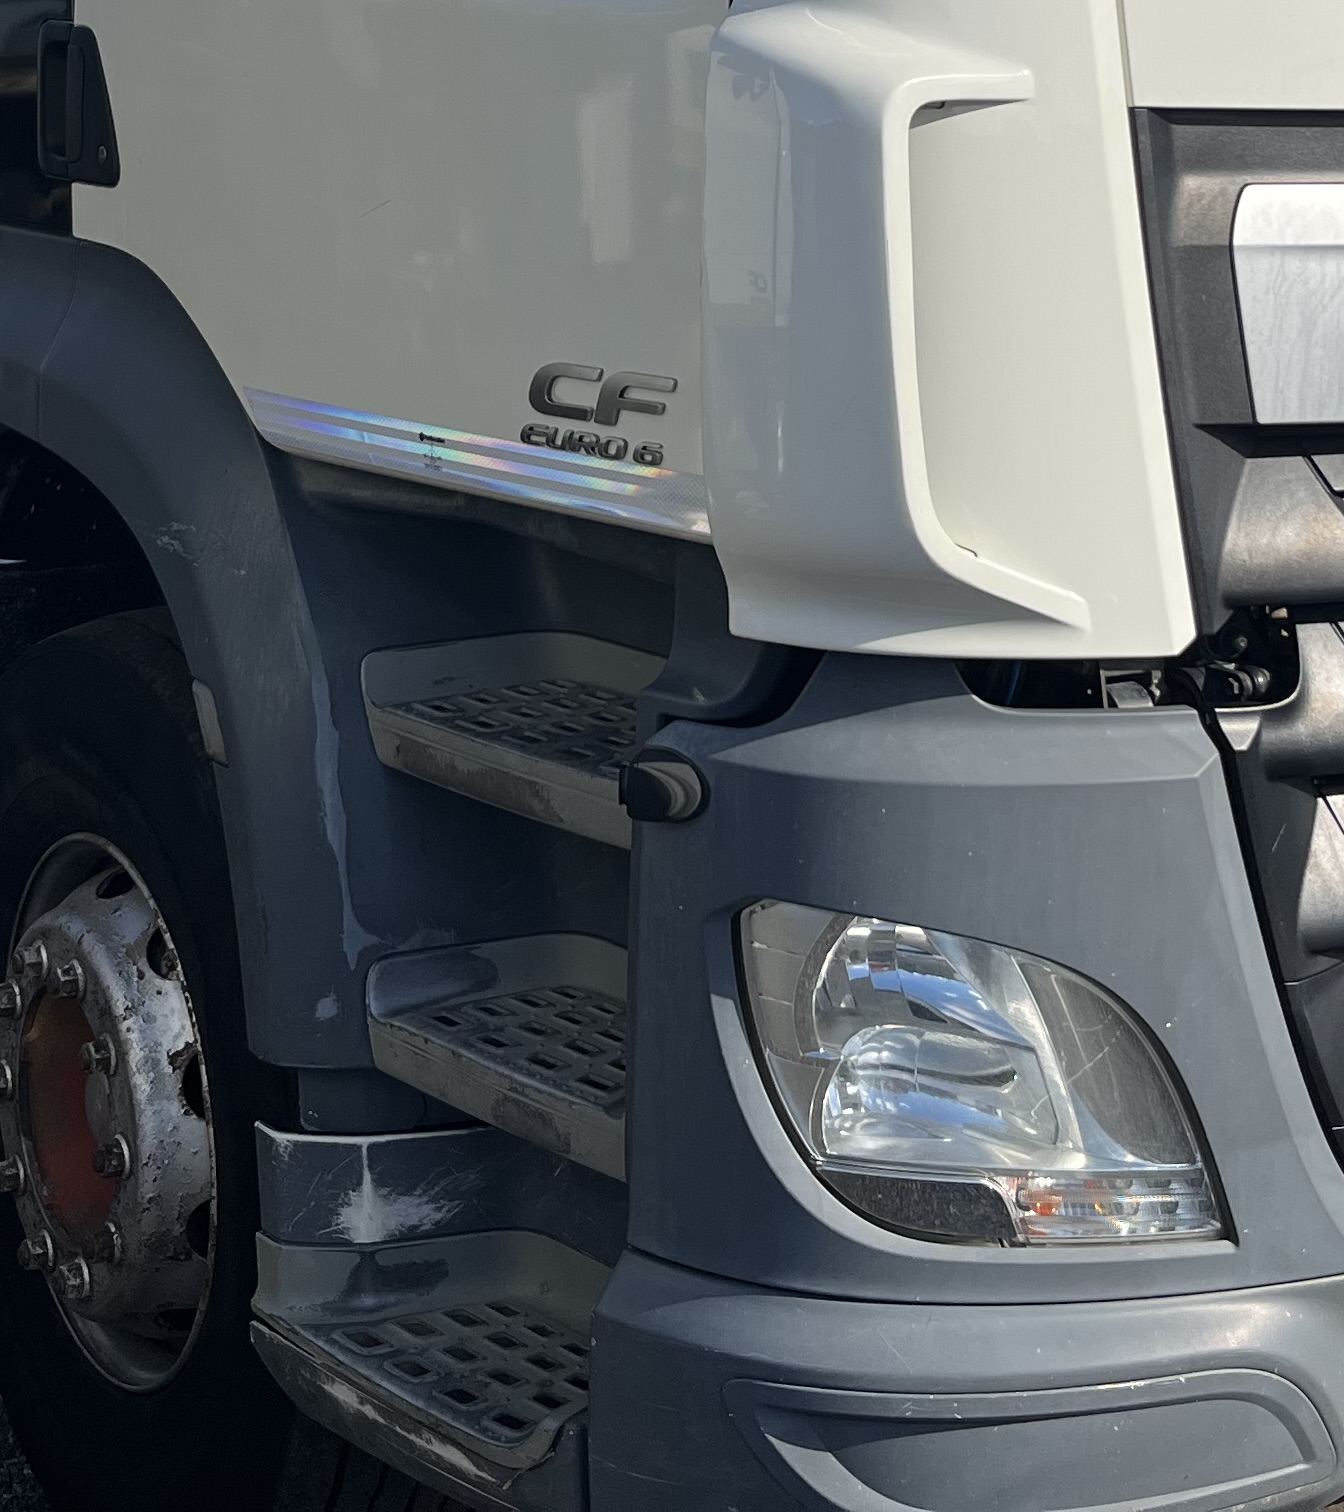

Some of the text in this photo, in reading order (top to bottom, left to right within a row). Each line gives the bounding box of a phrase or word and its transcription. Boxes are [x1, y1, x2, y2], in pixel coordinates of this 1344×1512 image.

[528, 361, 678, 426] CF
[520, 422, 664, 465] EURO 6
